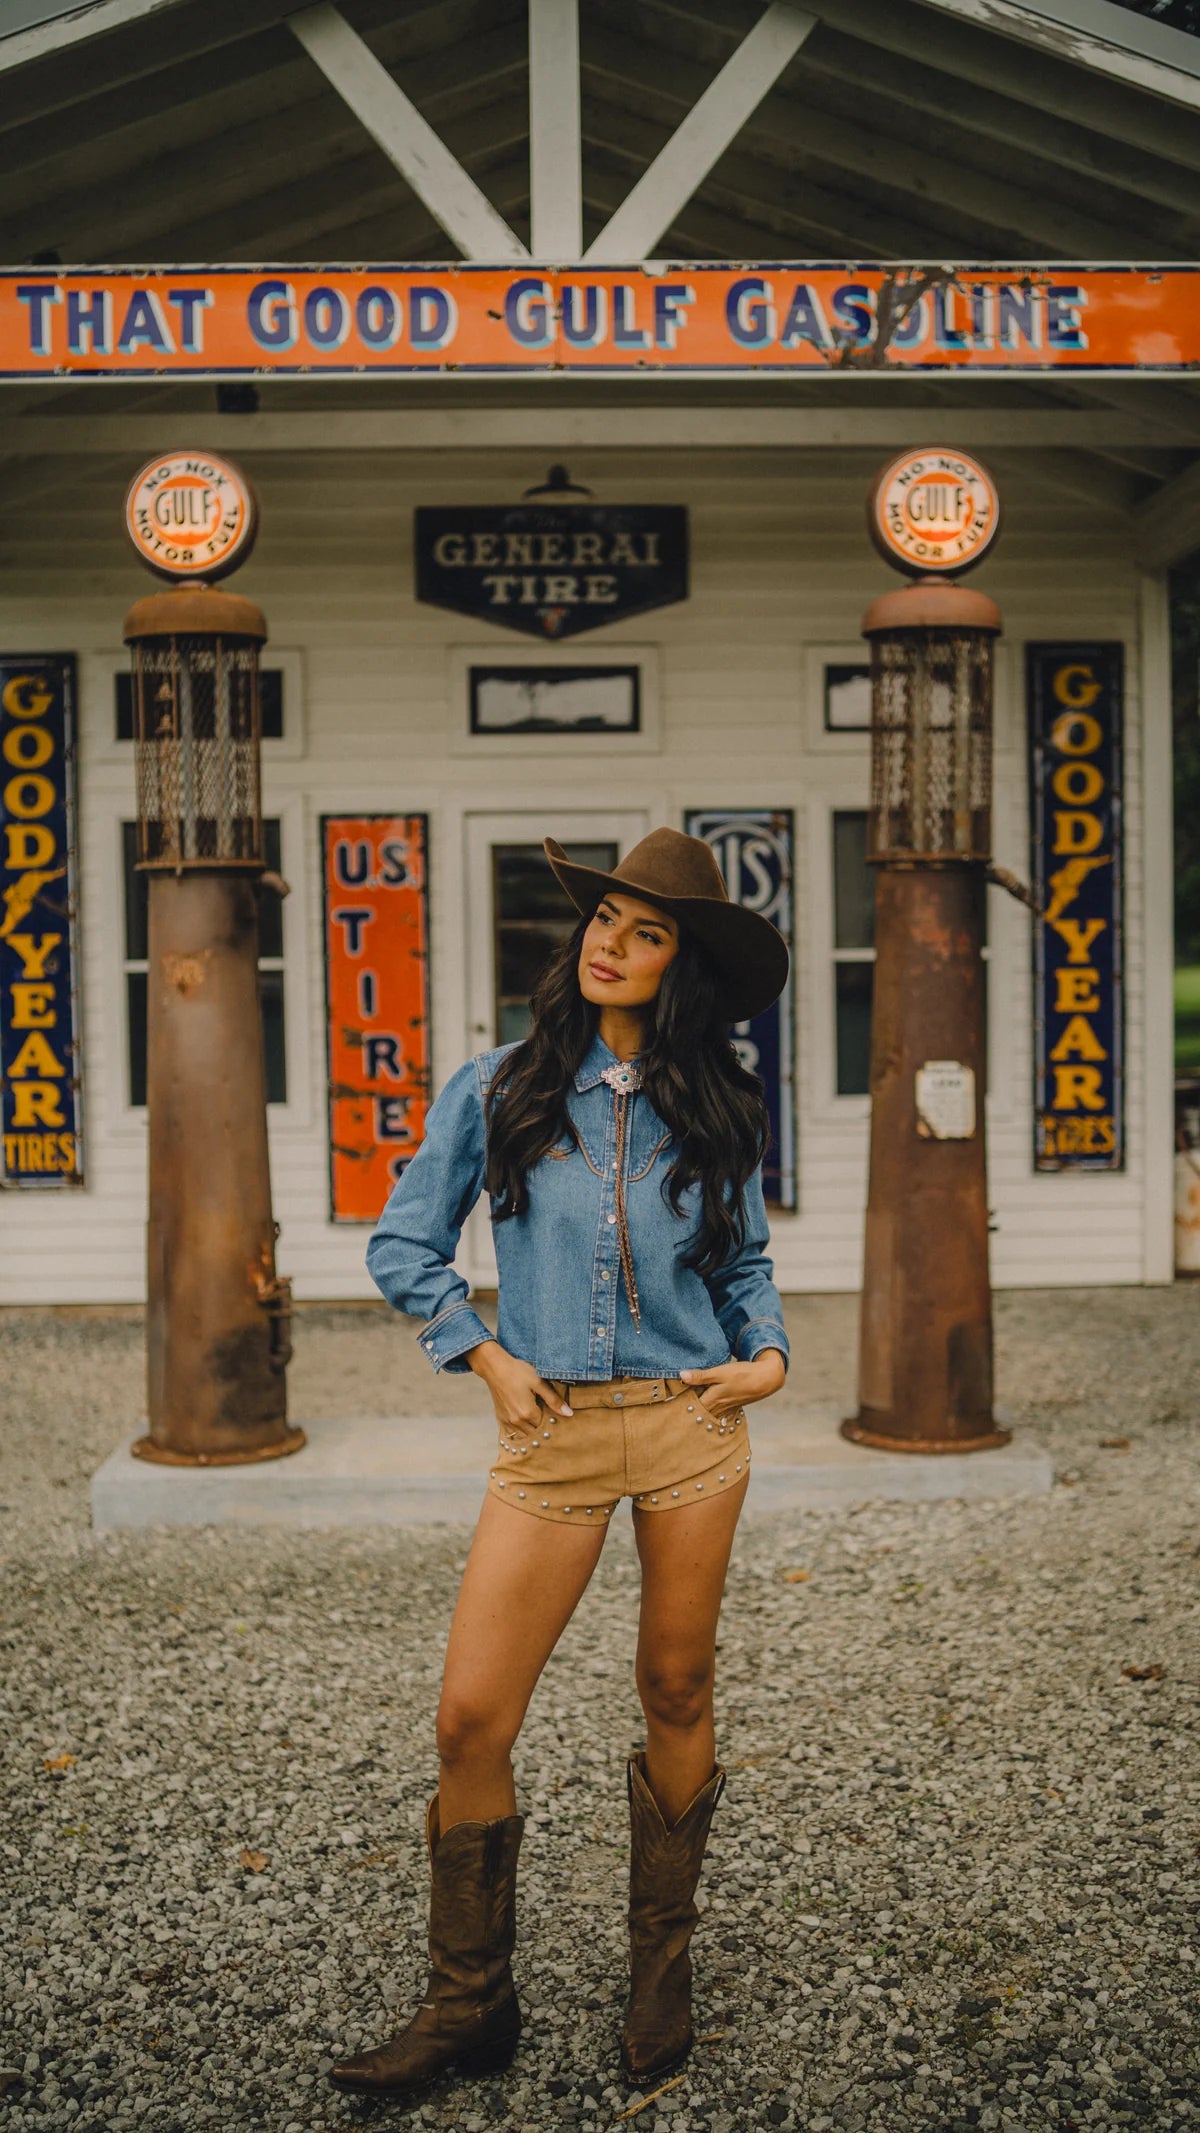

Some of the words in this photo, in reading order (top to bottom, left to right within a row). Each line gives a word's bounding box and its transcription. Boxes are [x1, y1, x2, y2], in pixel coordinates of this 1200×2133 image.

[17, 285, 214, 355] THAT
[247, 280, 458, 352] GOOD
[504, 278, 697, 351] GULF
[155, 489, 212, 526] GULF
[907, 486, 964, 522] GULF
[137, 509, 194, 562] MOTOR
[207, 507, 239, 554] FUEL
[889, 503, 944, 557] MOTOR
[957, 505, 988, 551] FUEL
[482, 574, 619, 604] TIRE
[3, 1132, 76, 1173] TIRES
